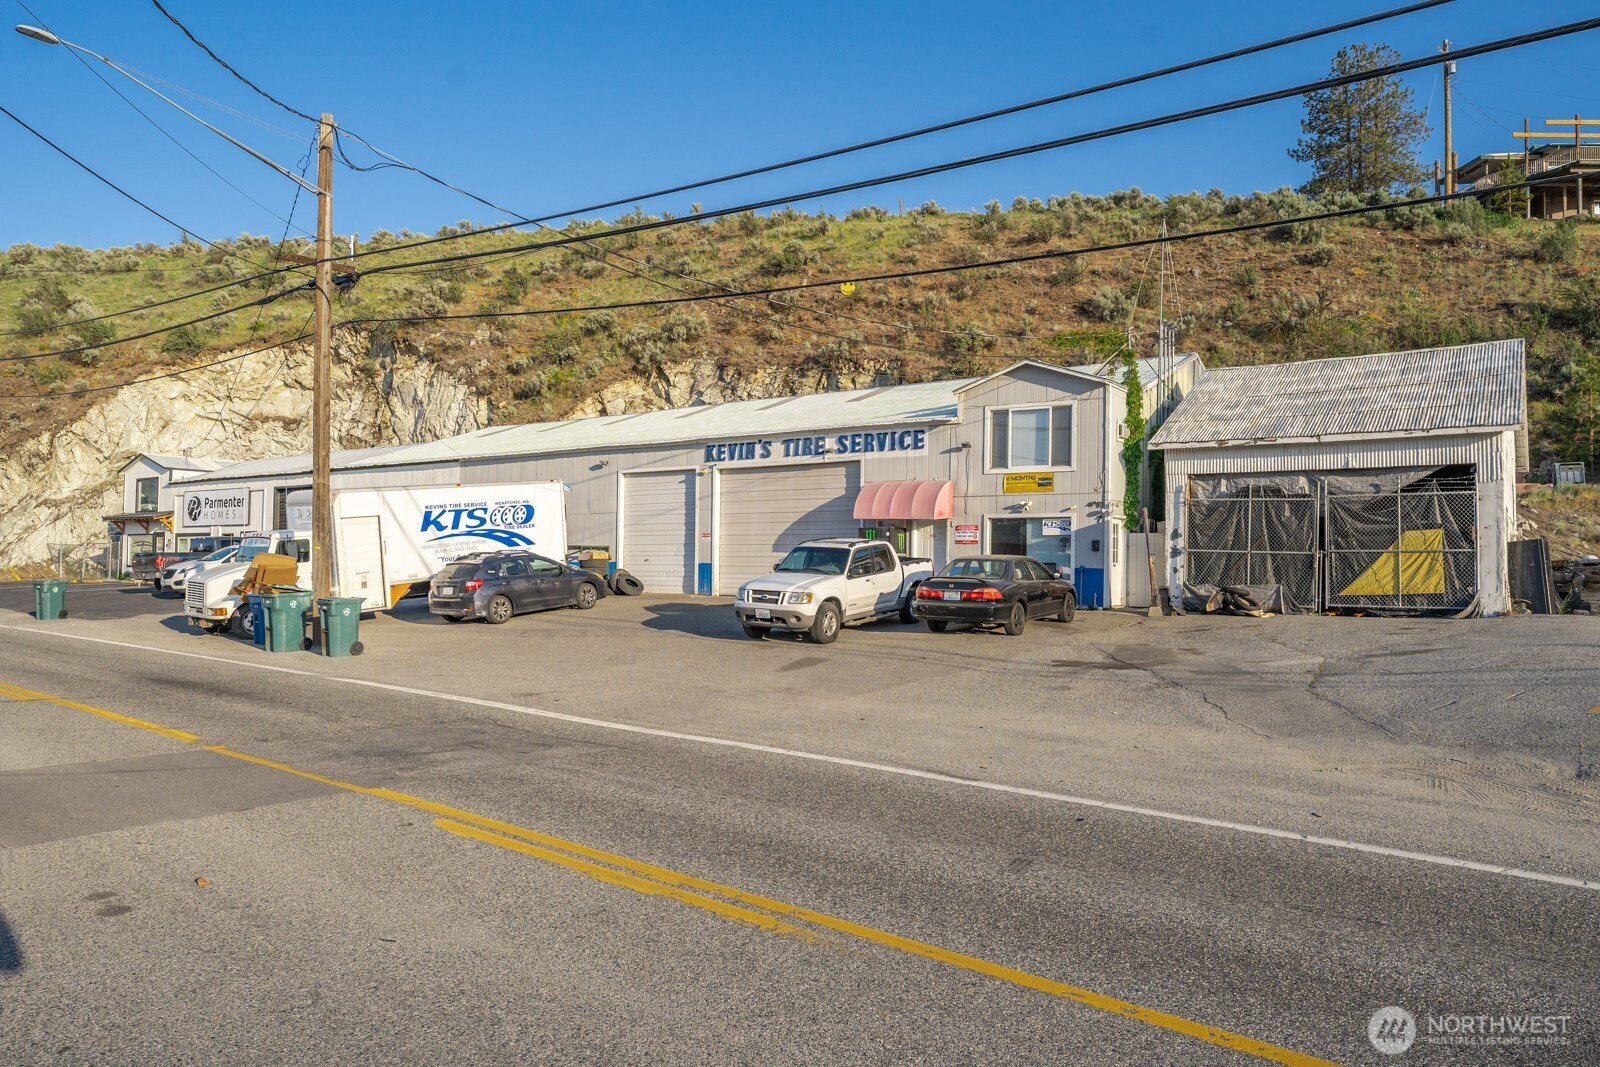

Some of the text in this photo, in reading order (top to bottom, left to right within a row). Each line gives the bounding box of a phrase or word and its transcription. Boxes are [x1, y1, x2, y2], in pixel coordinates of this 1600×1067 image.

[704, 430, 925, 463] KEVIN'S TIRE SERVICE
[204, 496, 244, 509] Parmenter
[203, 509, 237, 520] HOMES
